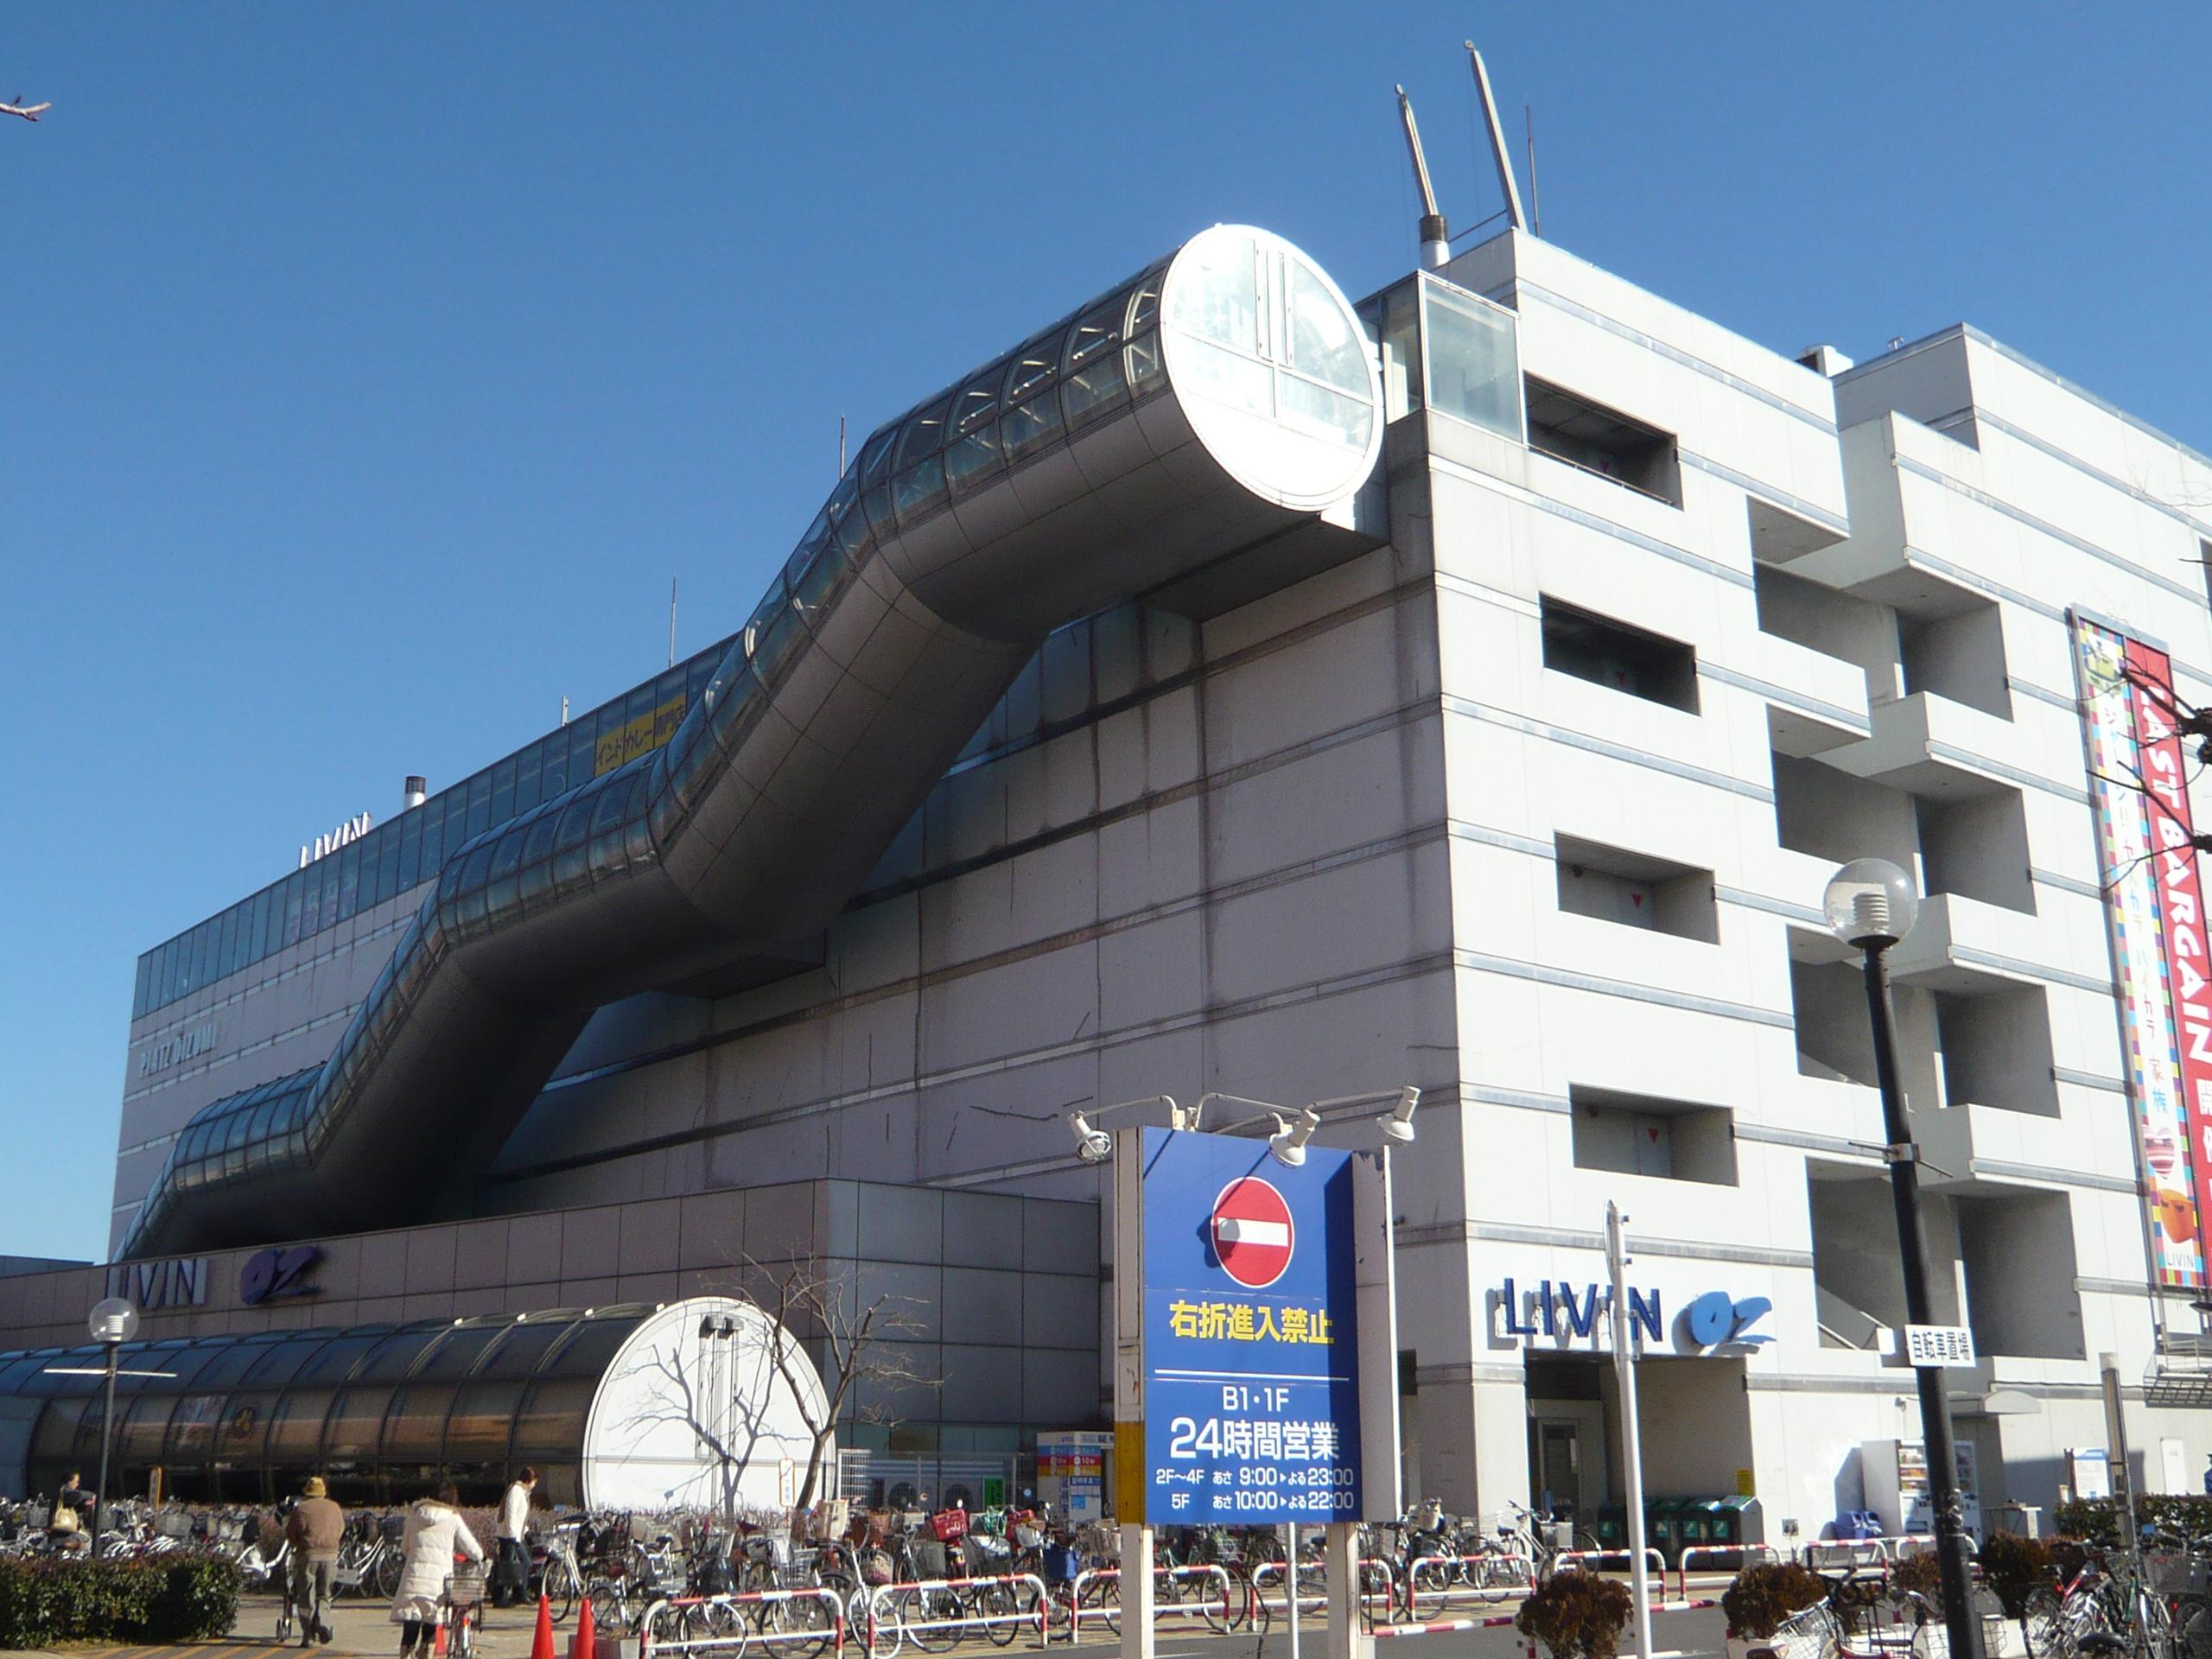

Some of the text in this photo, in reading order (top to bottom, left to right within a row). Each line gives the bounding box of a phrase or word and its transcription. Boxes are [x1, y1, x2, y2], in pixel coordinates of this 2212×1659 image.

[2140, 685, 2212, 1065] LAST BARGAIN
[2166, 1252, 2194, 1268] LIVIN
[1169, 1299, 1334, 1344] 右折進入禁止
[1170, 1416, 1339, 1461] 24時間営業
[1172, 1493, 1191, 1510] 5F
